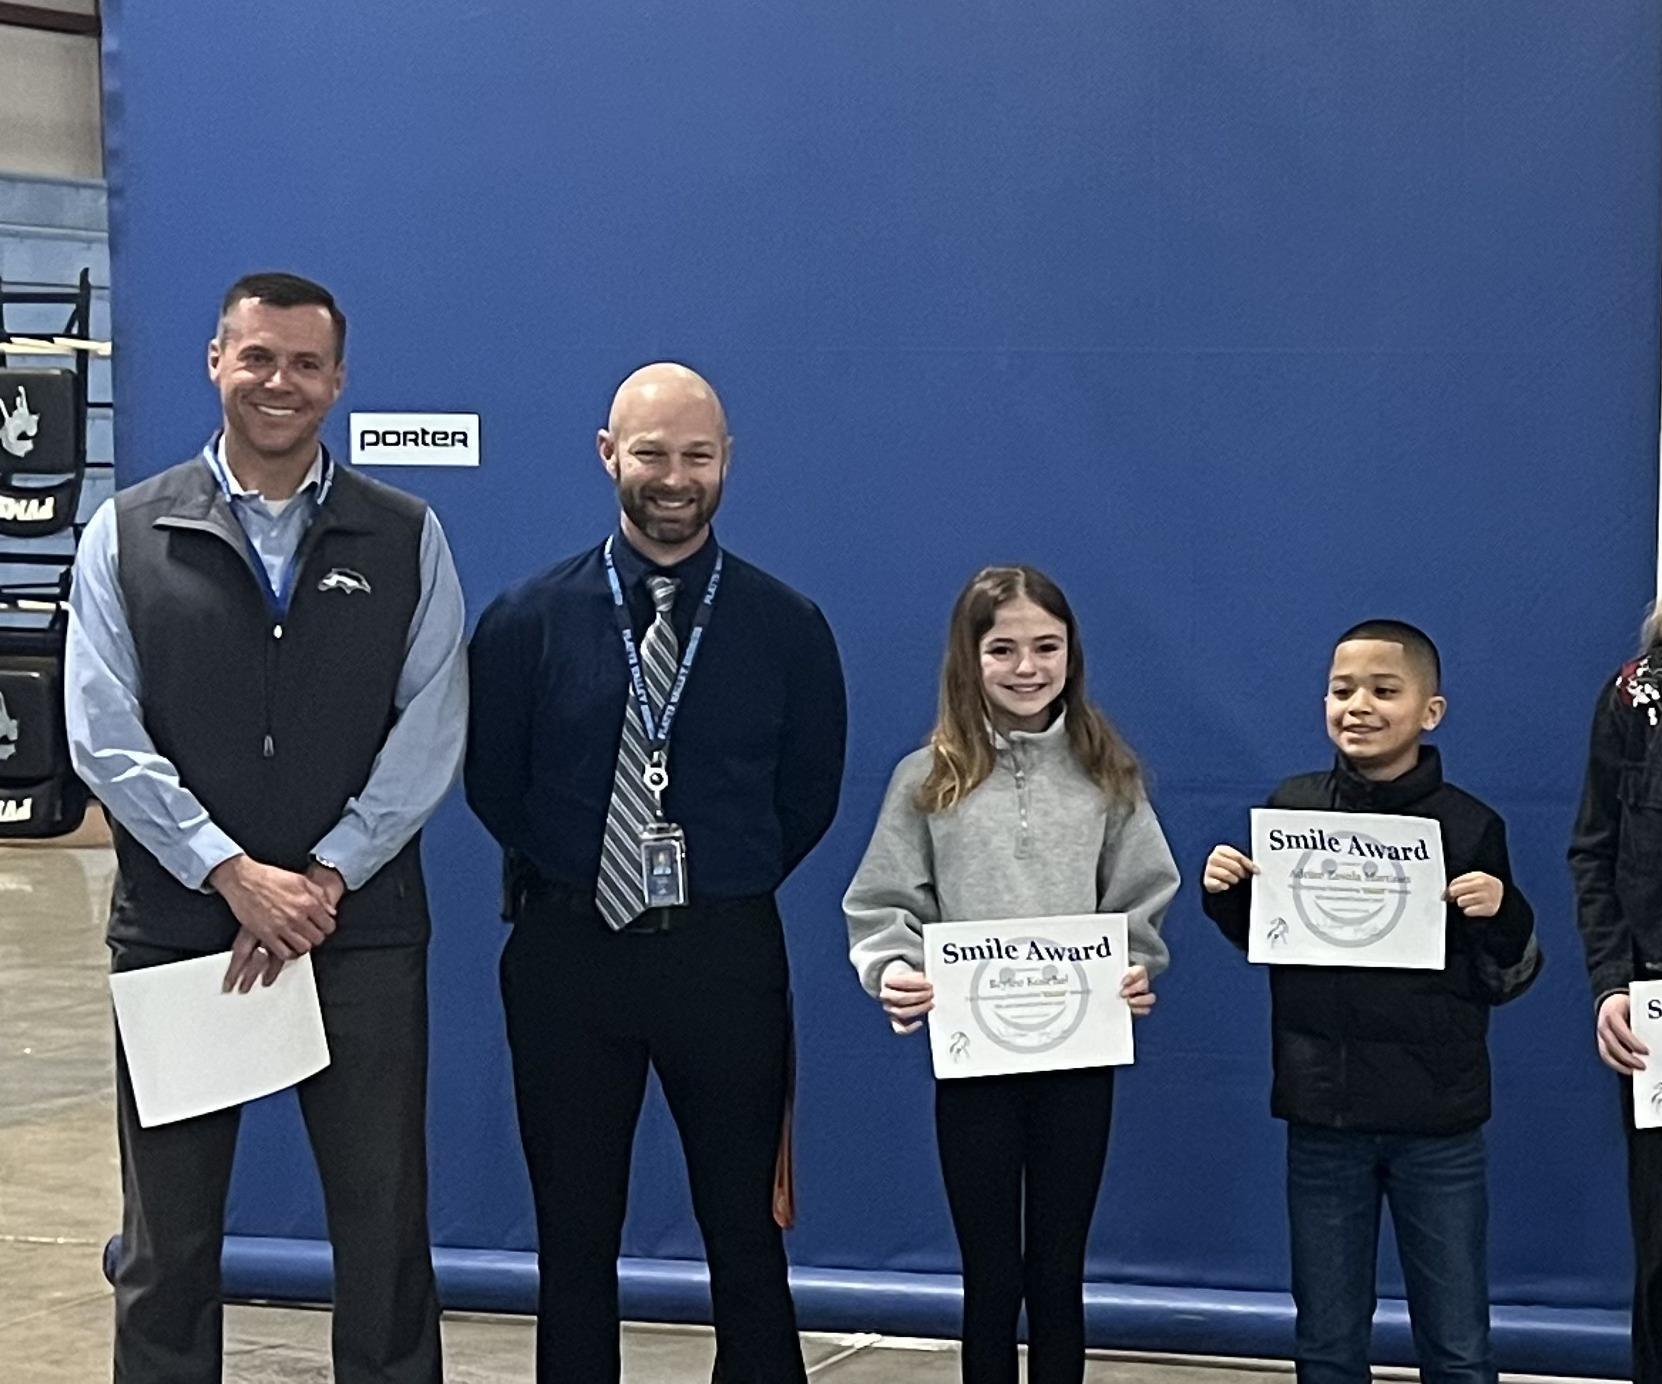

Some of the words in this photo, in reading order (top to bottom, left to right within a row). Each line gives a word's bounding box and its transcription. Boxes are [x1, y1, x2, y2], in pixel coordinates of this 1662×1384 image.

[1269, 828, 1341, 853] Smile
[1348, 835, 1430, 861] Award
[942, 938, 1019, 964] Smile
[1026, 936, 1112, 962] Award
